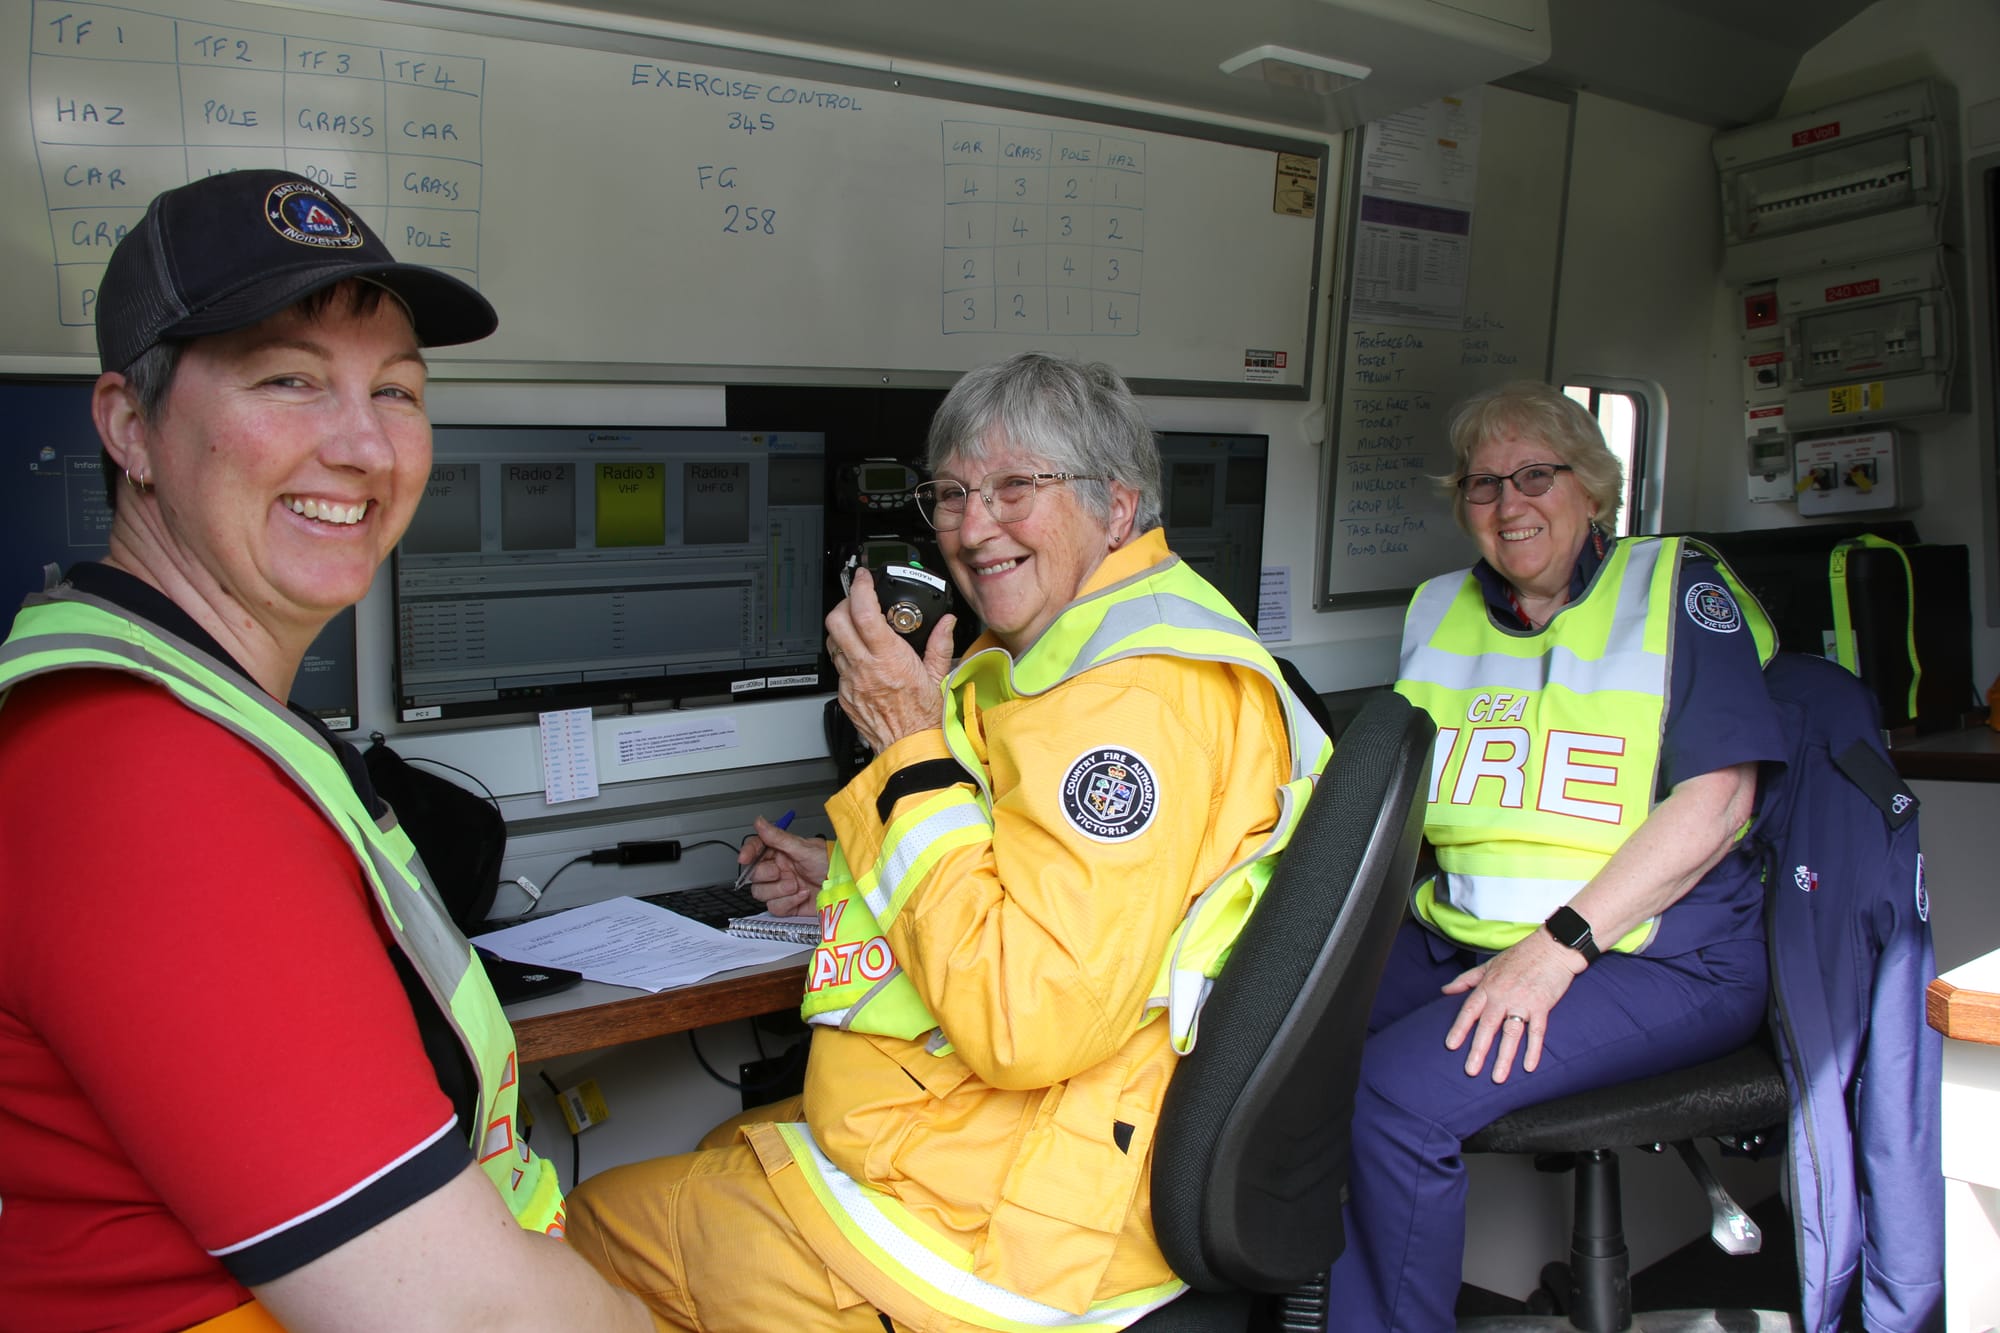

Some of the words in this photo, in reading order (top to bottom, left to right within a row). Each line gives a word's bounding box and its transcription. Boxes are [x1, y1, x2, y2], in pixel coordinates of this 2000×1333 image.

[49, 13, 93, 45] TF
[193, 35, 229, 57] TF
[235, 40, 253, 62] 2
[298, 51, 328, 69] TF
[336, 54, 351, 74] 3
[394, 60, 426, 82] TF
[433, 65, 456, 90] 4
[630, 63, 762, 100] EXERCISE
[766, 85, 863, 111] CONTROL
[56, 95, 125, 126] HAZ
[203, 99, 259, 127] POLE
[297, 107, 375, 138] GRASS
[402, 120, 458, 141] CAR
[727, 111, 775, 136] 345
[1813, 125, 1836, 140] Volt
[952, 141, 984, 154] CAR
[1003, 142, 1043, 161] GRASS
[1060, 147, 1091, 162] POLE
[1106, 152, 1137, 167] HAZ
[62, 164, 127, 191] CAR
[403, 171, 459, 201] GRASS
[963, 177, 979, 197] 4
[1013, 177, 1027, 197] 3
[1064, 178, 1079, 199] 2
[273, 184, 326, 198] NATIONAL
[722, 204, 777, 236] 258
[1012, 216, 1029, 238] 4
[1059, 215, 1073, 237] 3
[1107, 217, 1123, 240] 2
[283, 228, 342, 246] INCIDENT
[406, 225, 452, 249] POLE
[962, 258, 976, 280] 2
[1063, 255, 1076, 277] 4
[1107, 258, 1120, 281] 3
[962, 297, 976, 321] 3
[1012, 293, 1026, 318] 2
[1107, 301, 1122, 328] 4
[509, 466, 552, 481] Radio
[555, 466, 565, 481] 2
[602, 466, 643, 480] Radio
[646, 466, 655, 480] 3
[690, 465, 729, 479] Radio
[731, 465, 740, 479] 4
[525, 485, 550, 496] VHF
[618, 483, 640, 494] VHF
[696, 482, 717, 493] UHF
[719, 482, 734, 493] CB
[1466, 692, 1529, 723] CFA
[1066, 755, 1097, 796] COUNTRY
[1103, 751, 1128, 764] FIRE
[1130, 762, 1153, 818] AUTHORITY
[1074, 812, 1129, 837] VICTORIA
